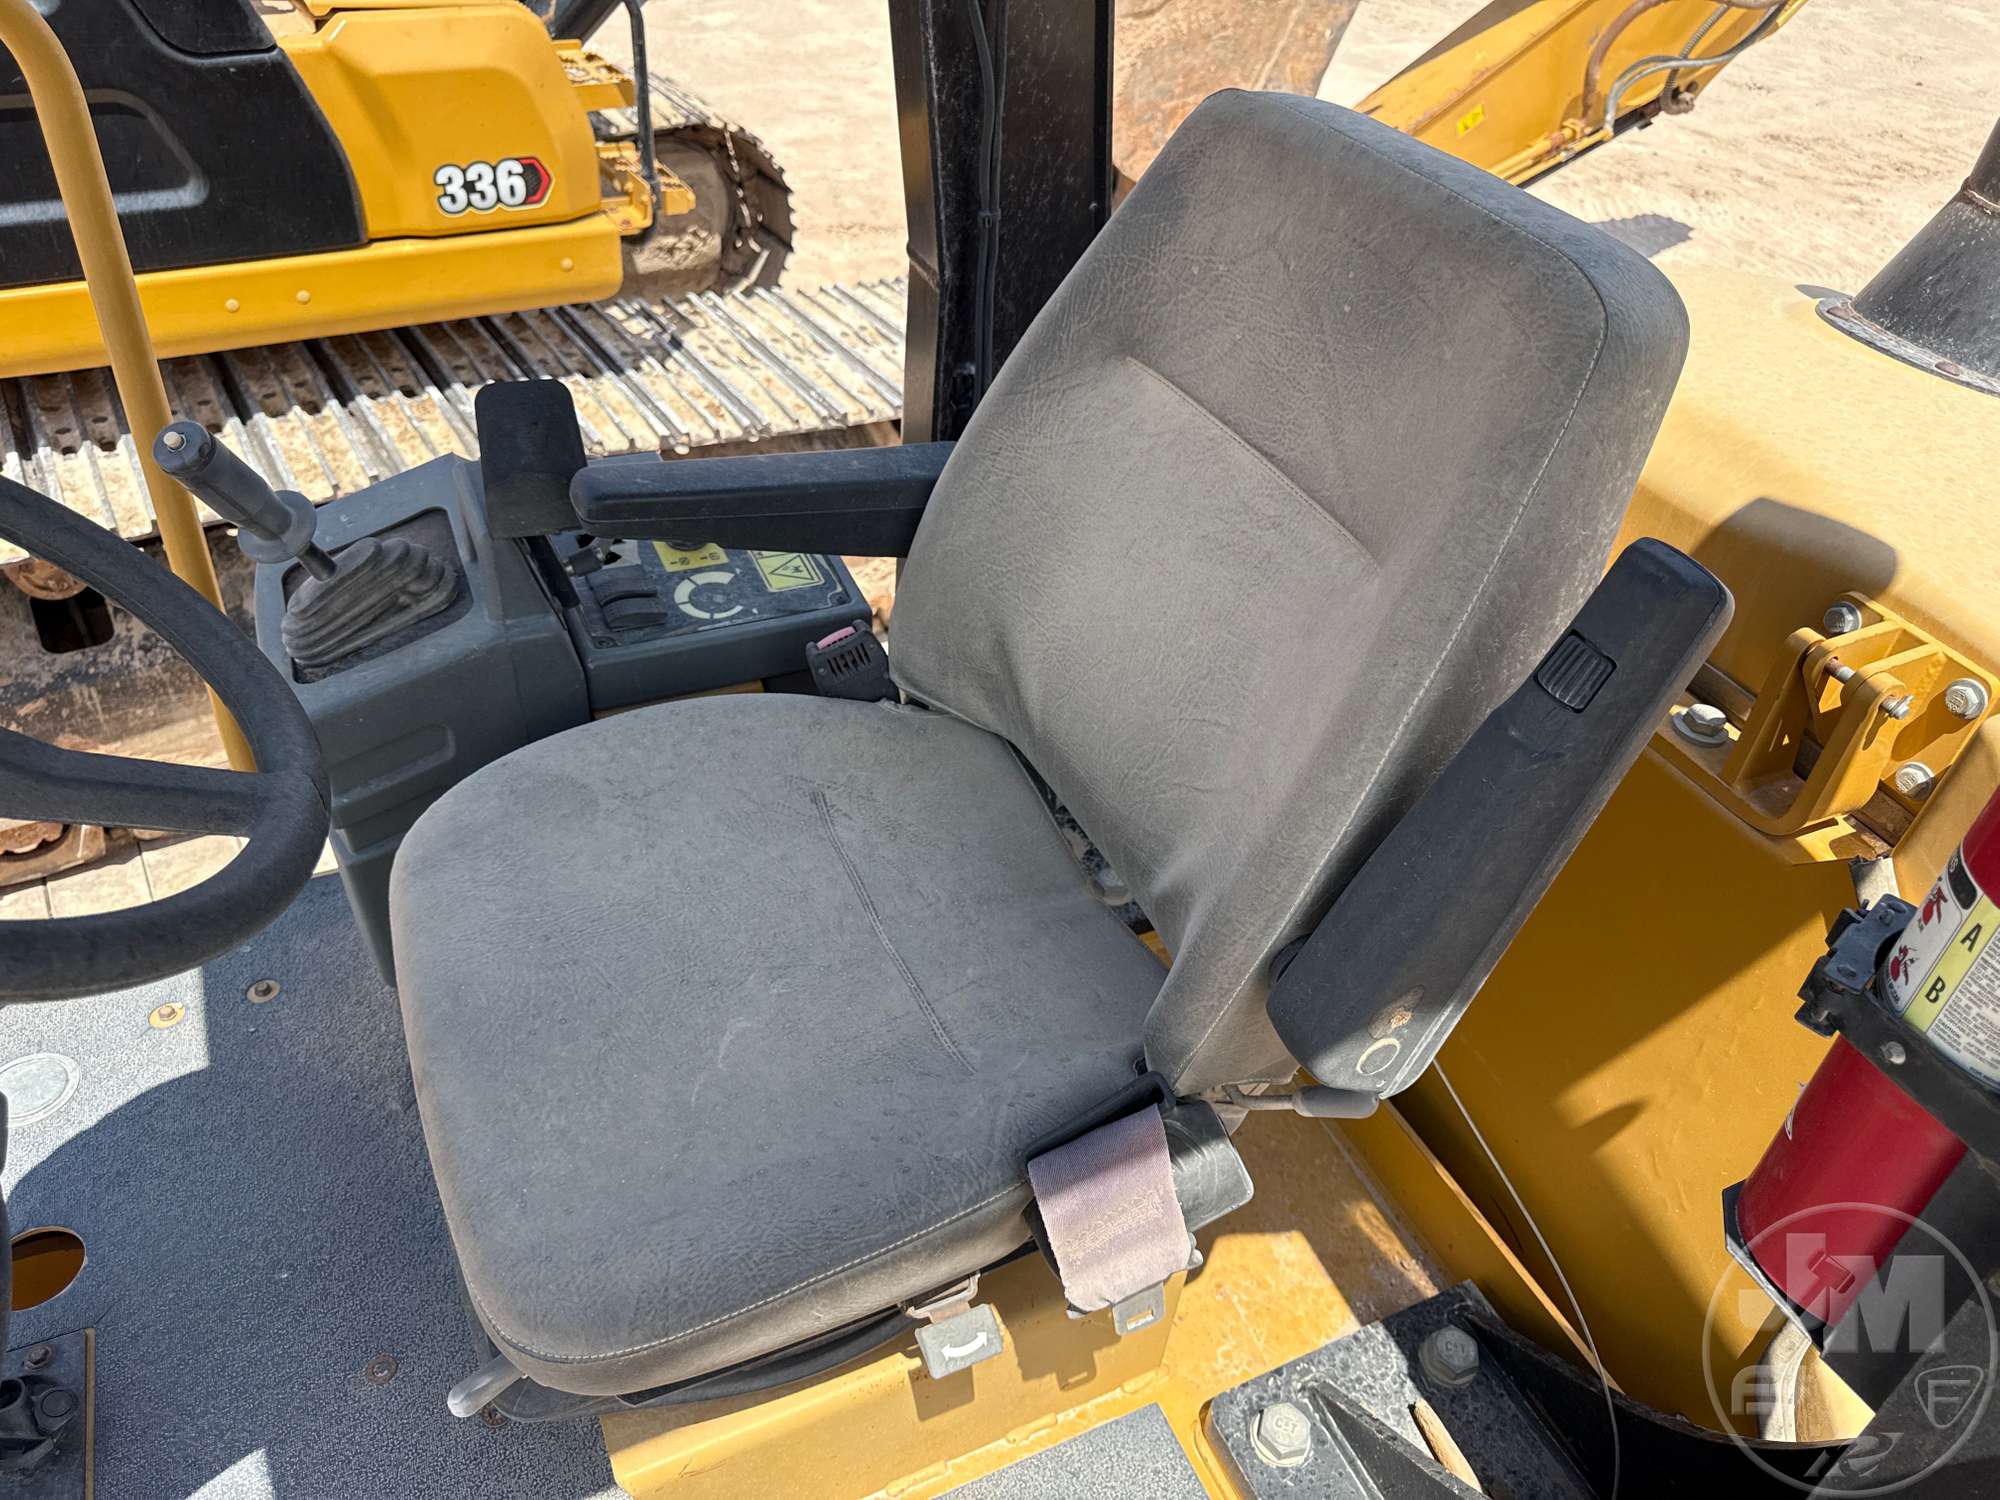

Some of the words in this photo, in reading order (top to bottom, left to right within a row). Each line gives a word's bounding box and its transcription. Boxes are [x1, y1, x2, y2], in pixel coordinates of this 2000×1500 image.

[434, 158, 527, 213] 336
[1960, 923, 1983, 953] A
[1925, 976, 1946, 1003] B
